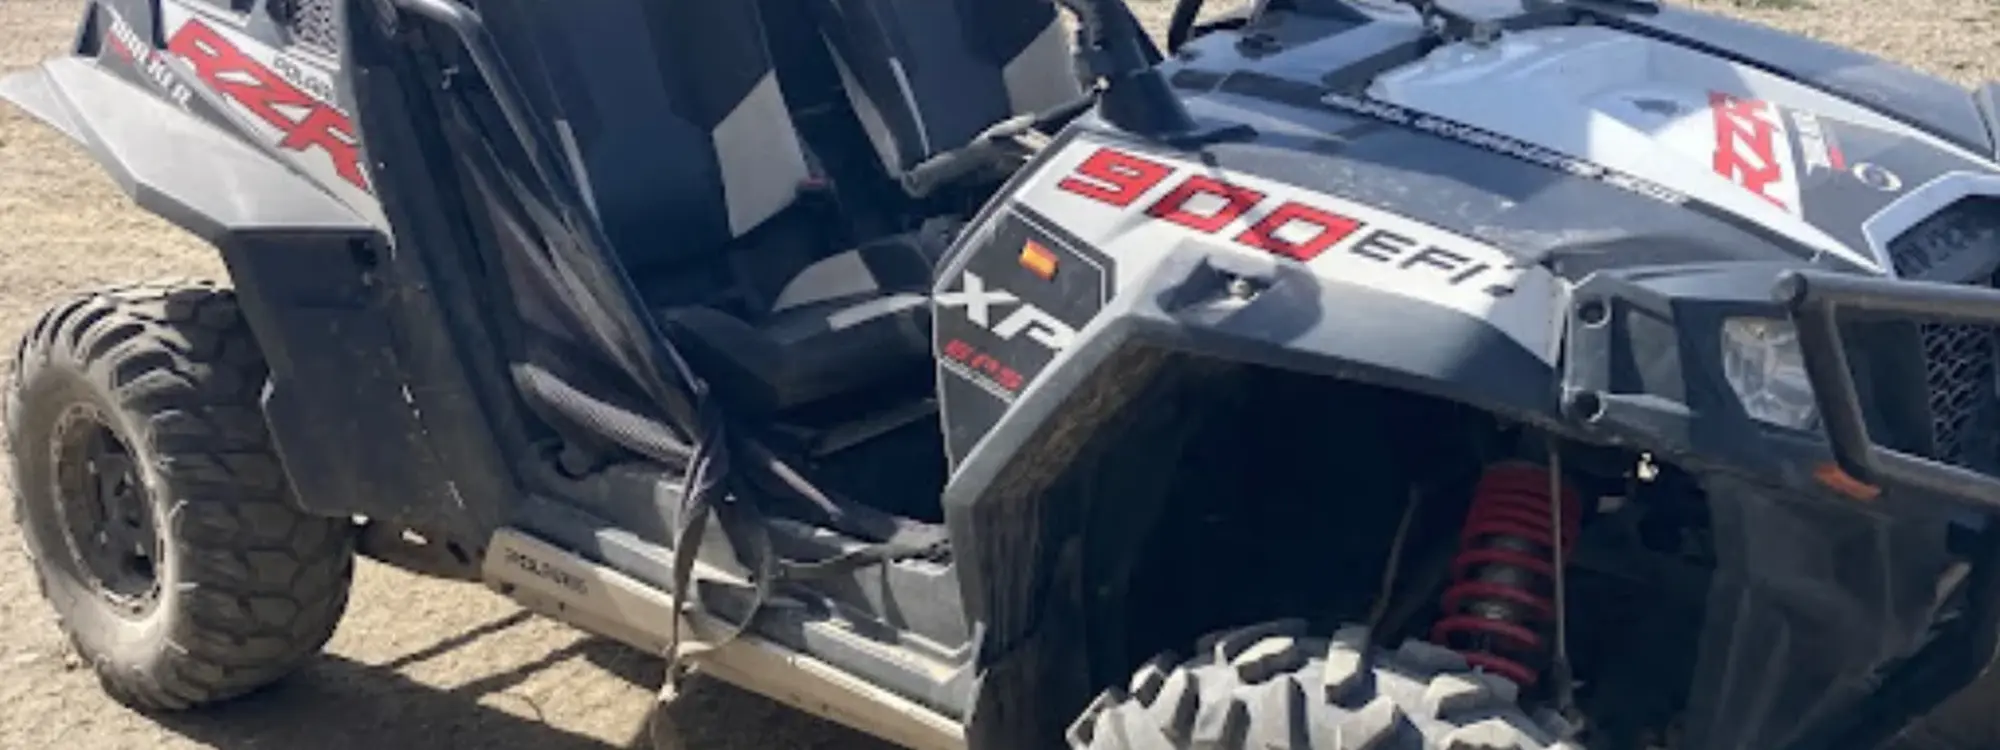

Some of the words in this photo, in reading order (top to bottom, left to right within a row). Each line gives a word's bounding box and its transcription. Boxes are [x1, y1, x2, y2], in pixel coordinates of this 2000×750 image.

[166, 18, 372, 191] RZR
[1707, 90, 1789, 212] RZR
[1057, 146, 1367, 263] 900
[1348, 228, 1488, 285] EFI
[935, 269, 1084, 352] XP
